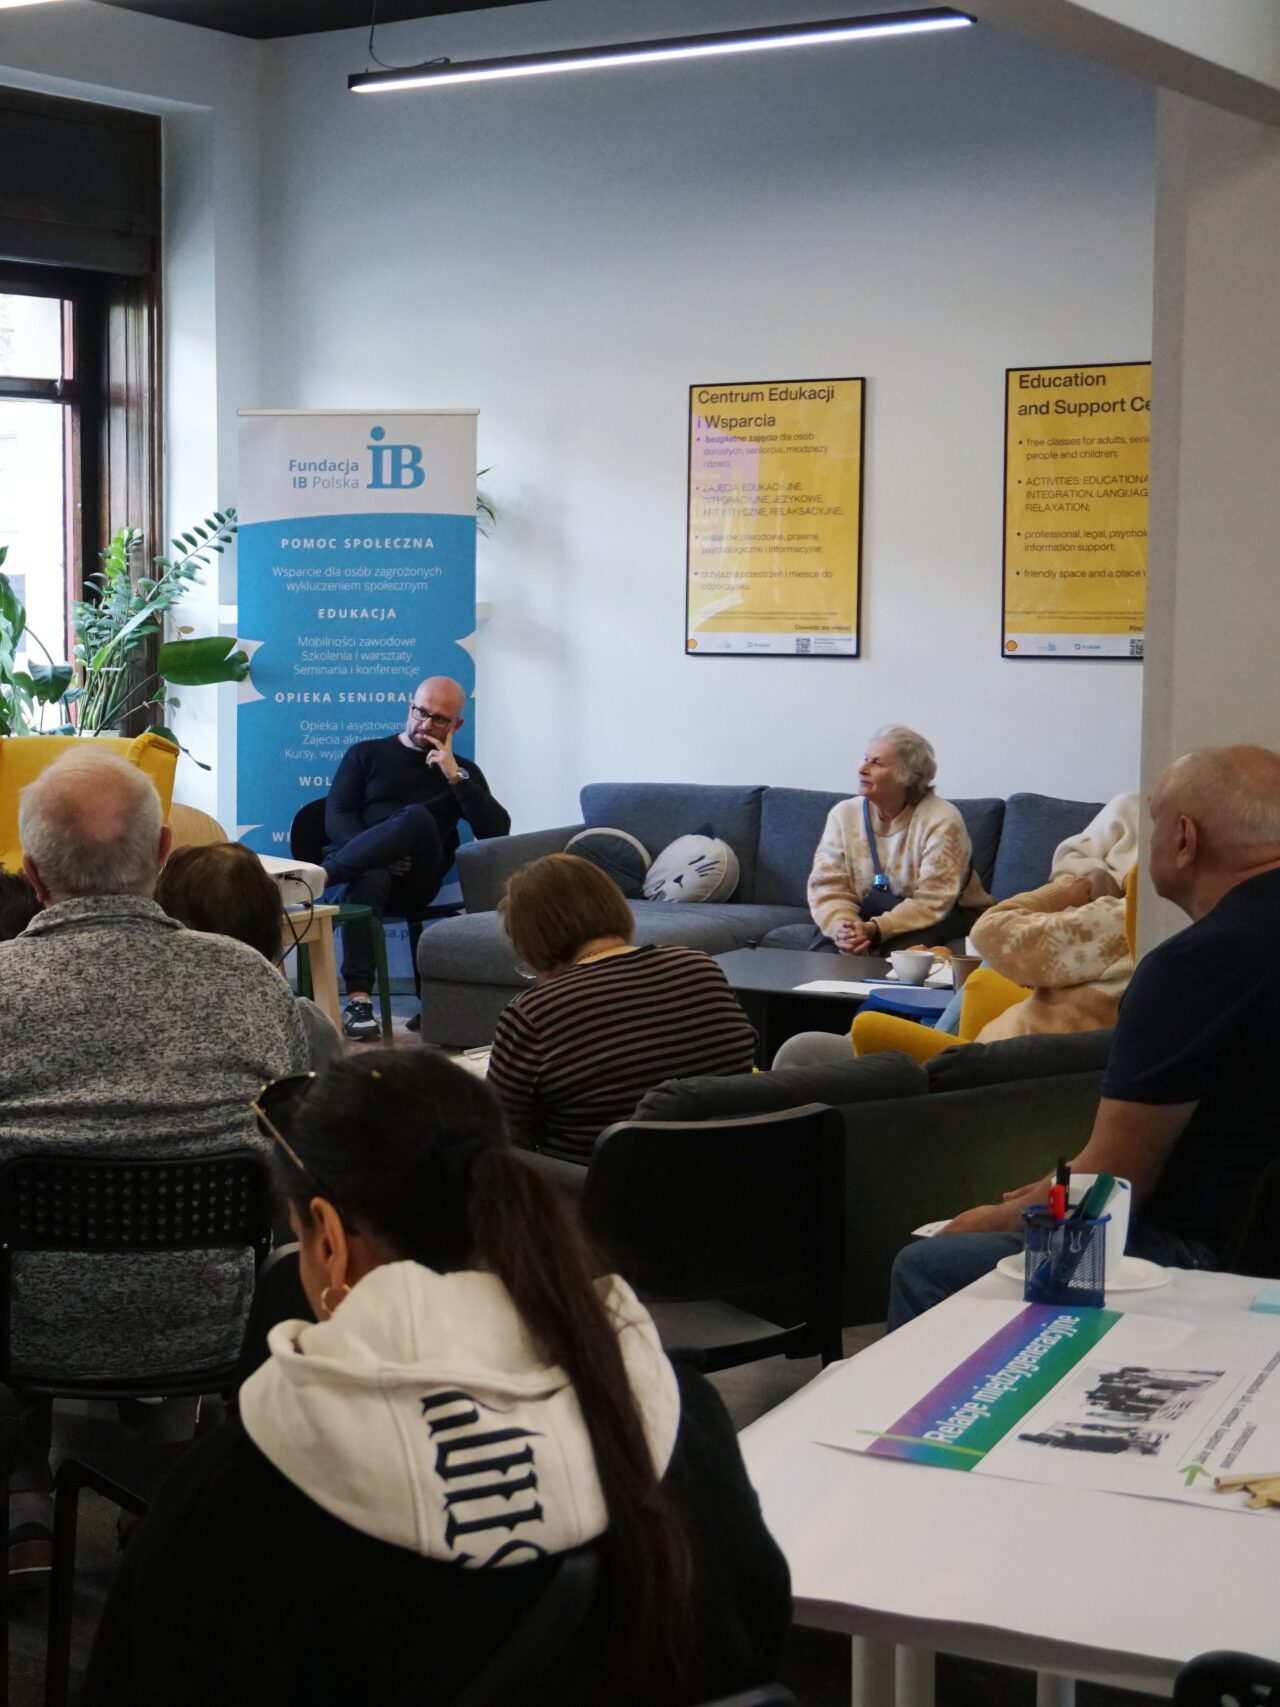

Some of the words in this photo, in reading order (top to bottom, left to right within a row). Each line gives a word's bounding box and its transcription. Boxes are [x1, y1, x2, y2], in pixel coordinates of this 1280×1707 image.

[1018, 373, 1106, 389] Education
[698, 389, 764, 405] Centrum
[768, 385, 835, 403] Edukacji
[1018, 400, 1050, 416] and
[1054, 397, 1126, 417] Support
[704, 414, 776, 433] Wsparcia
[1026, 437, 1045, 447] free
[1047, 437, 1081, 447] classes
[1082, 436, 1095, 446] for
[1097, 436, 1128, 447] adults,
[1026, 450, 1058, 461] people
[1060, 450, 1078, 459] and
[289, 459, 360, 475] Fundacja
[292, 477, 308, 489] IB
[312, 476, 360, 489] Polska
[1097, 488, 1148, 498] LANGUAG
[281, 538, 337, 549] POMOC
[344, 537, 434, 549] SPOŁECZNA
[1024, 542, 1076, 552] information
[272, 566, 322, 579] Wsparcie
[325, 566, 341, 577] dla
[344, 565, 371, 577] osób
[374, 565, 442, 580] zagrożonych
[1024, 568, 1057, 579] friendly
[1059, 569, 1087, 579] space
[1088, 568, 1106, 577] and
[286, 580, 362, 592] wykluczeniem
[364, 580, 428, 593] społecznym
[318, 608, 397, 620] EDUKACJA
[298, 636, 356, 648] Mobilności
[359, 637, 416, 647] zawodowe
[302, 650, 352, 661] Szkolenia
[361, 651, 412, 664] warsztaty
[293, 664, 347, 675] Seminaria
[356, 664, 420, 678] konferencje
[275, 692, 332, 703] OPIEKA
[300, 720, 338, 732] Opieka
[285, 750, 317, 762] Kursy,
[922, 1401, 991, 1443] Relacje
[972, 1314, 1080, 1403] międzygeneracyjne
